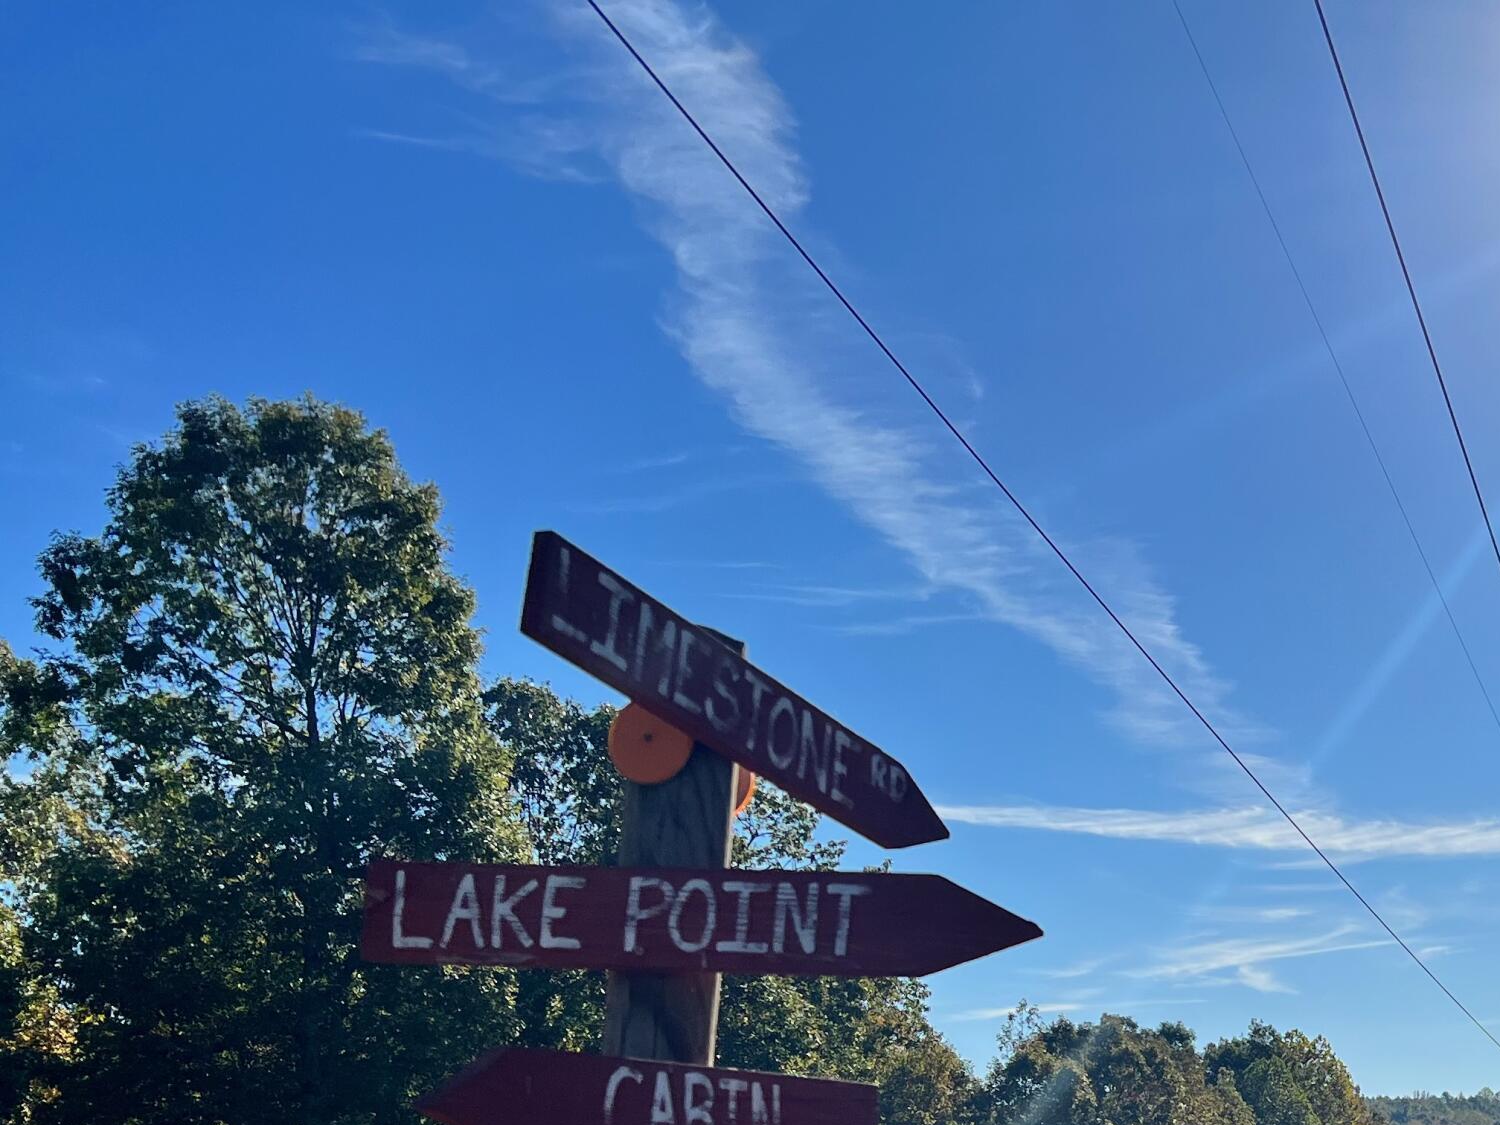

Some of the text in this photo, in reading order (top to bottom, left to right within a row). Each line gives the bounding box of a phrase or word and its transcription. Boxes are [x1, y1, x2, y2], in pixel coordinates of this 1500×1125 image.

[552, 547, 908, 809] LIMESTONE RD
[391, 870, 872, 955] LAKE POINT
